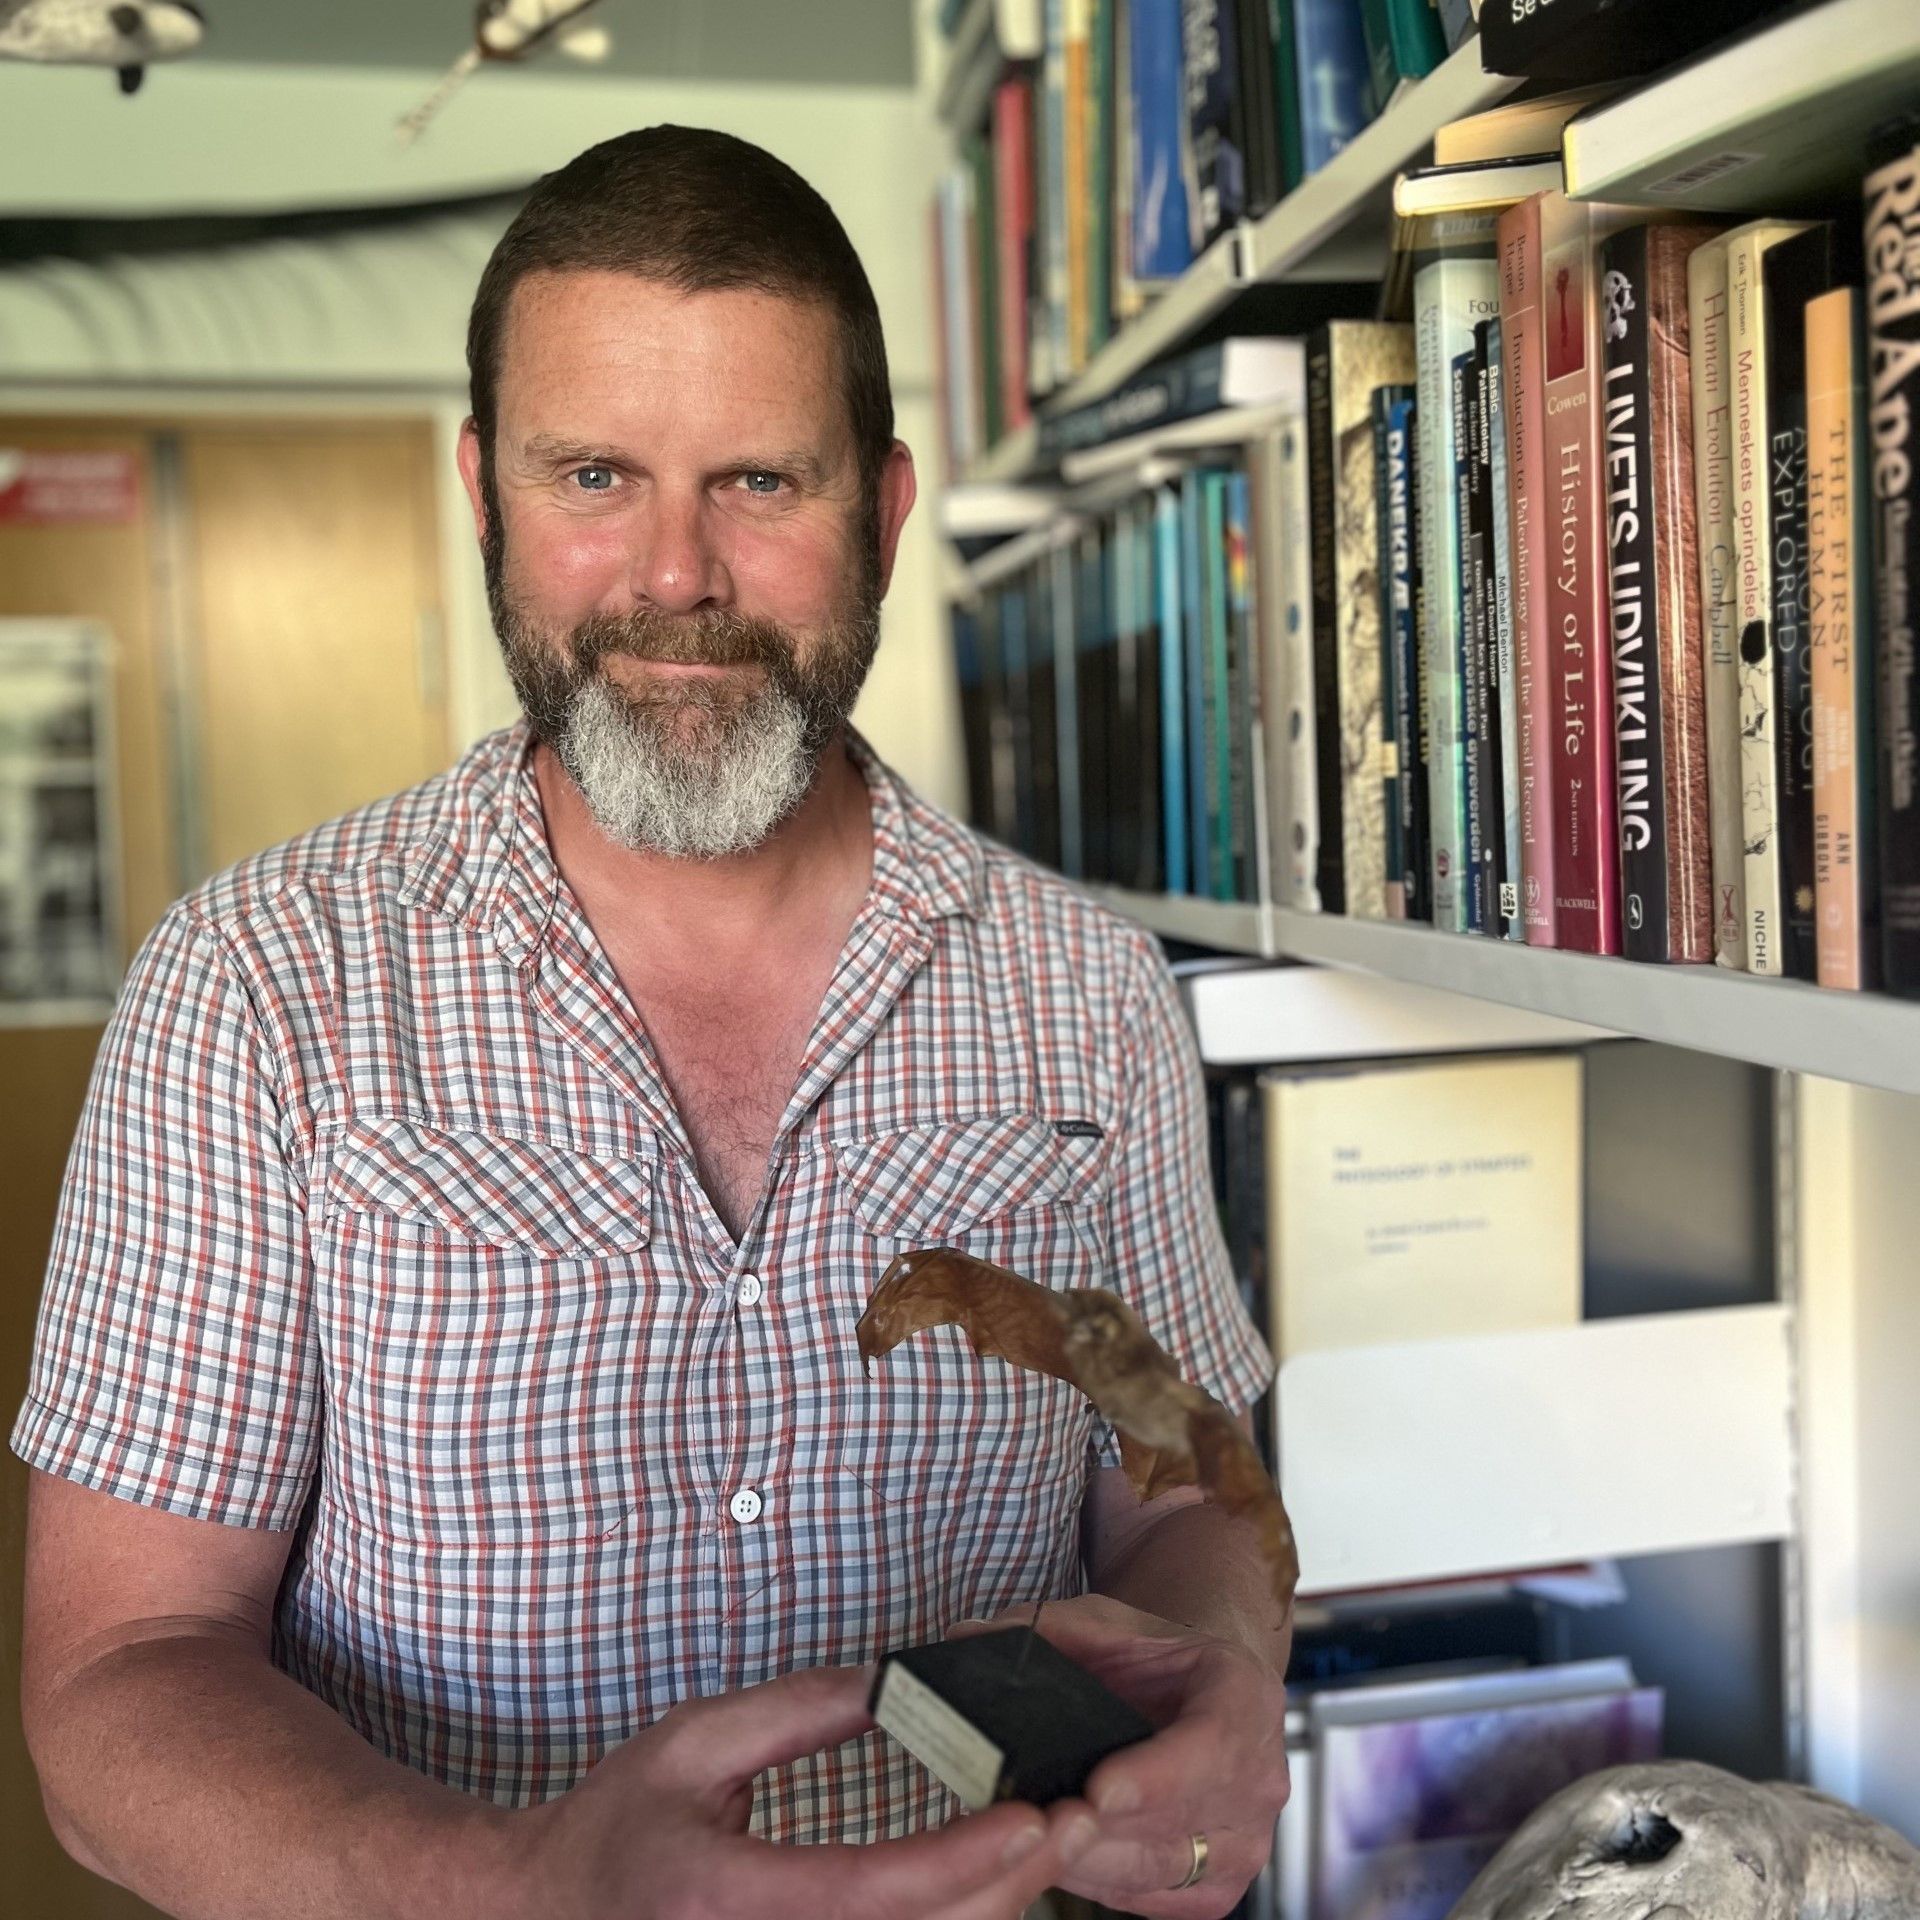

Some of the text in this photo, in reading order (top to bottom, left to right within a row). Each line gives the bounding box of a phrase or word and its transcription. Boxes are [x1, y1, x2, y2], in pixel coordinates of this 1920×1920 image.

[1504, 242, 1517, 296] Harper
[1516, 235, 1528, 292] Benton
[1737, 253, 1747, 276] Erik
[1863, 145, 1920, 327] Red
[1478, 369, 1491, 465] Palaeontology
[1489, 365, 1500, 413] Basic
[1547, 388, 1587, 418] Cowen
[1703, 291, 1729, 525] Human Evolution
[1869, 335, 1920, 500] Ape
[1469, 400, 1479, 451] Richard
[1737, 350, 1760, 618] Menneskets oprindelse
[1773, 431, 1797, 653] EXPLORED
[1810, 470, 1826, 649] HUMAN
[1829, 420, 1849, 674] THE FIRST
[1511, 332, 1536, 843] Introduction to Paleobiology and the Fossil Record
[1558, 443, 1585, 756] History of Life
[1604, 362, 1652, 852] LIVETS UDVIKLING
[1709, 545, 1734, 665] Campbell
[1476, 613, 1486, 639] The
[1476, 642, 1486, 667] Key
[1486, 578, 1499, 687] and David Harper
[1498, 576, 1511, 674] Michael Benton
[1478, 671, 1487, 685] to
[1479, 688, 1489, 710] the
[1480, 714, 1489, 741] Past
[1570, 778, 1582, 809] 2ND
[1815, 814, 1829, 884] GIBBONS
[1836, 832, 1850, 865] ANN
[1754, 910, 1767, 969] NICHE
